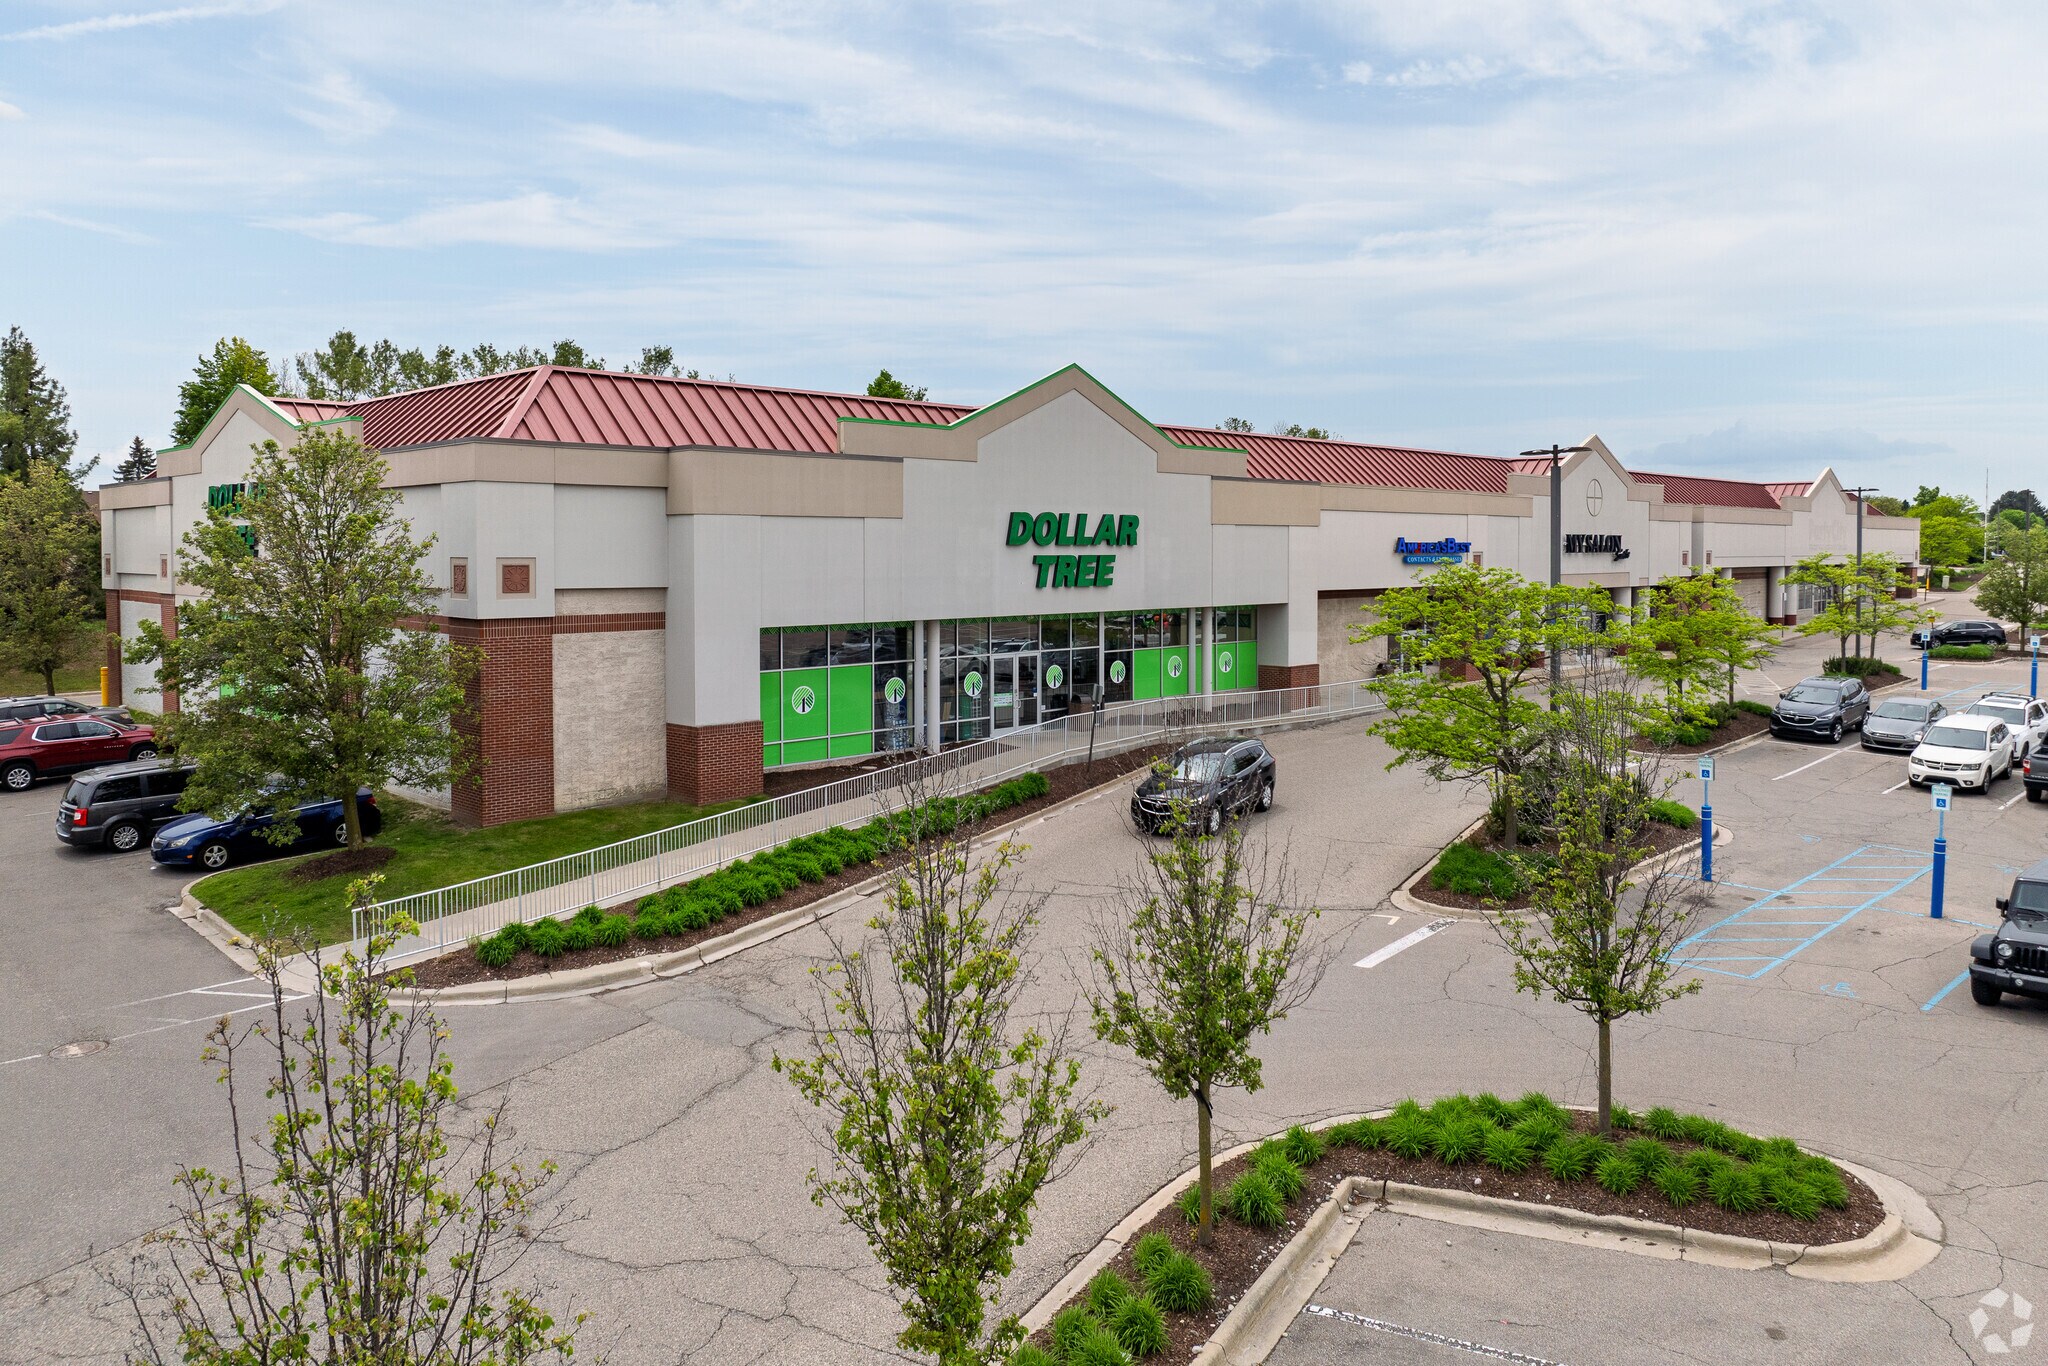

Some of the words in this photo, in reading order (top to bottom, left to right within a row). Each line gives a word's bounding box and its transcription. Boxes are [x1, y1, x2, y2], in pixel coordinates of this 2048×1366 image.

[1006, 511, 1140, 546] DOLLAR
[1565, 534, 1586, 553] MY
[1585, 534, 1622, 553] SALON
[1032, 554, 1116, 588] TREE
